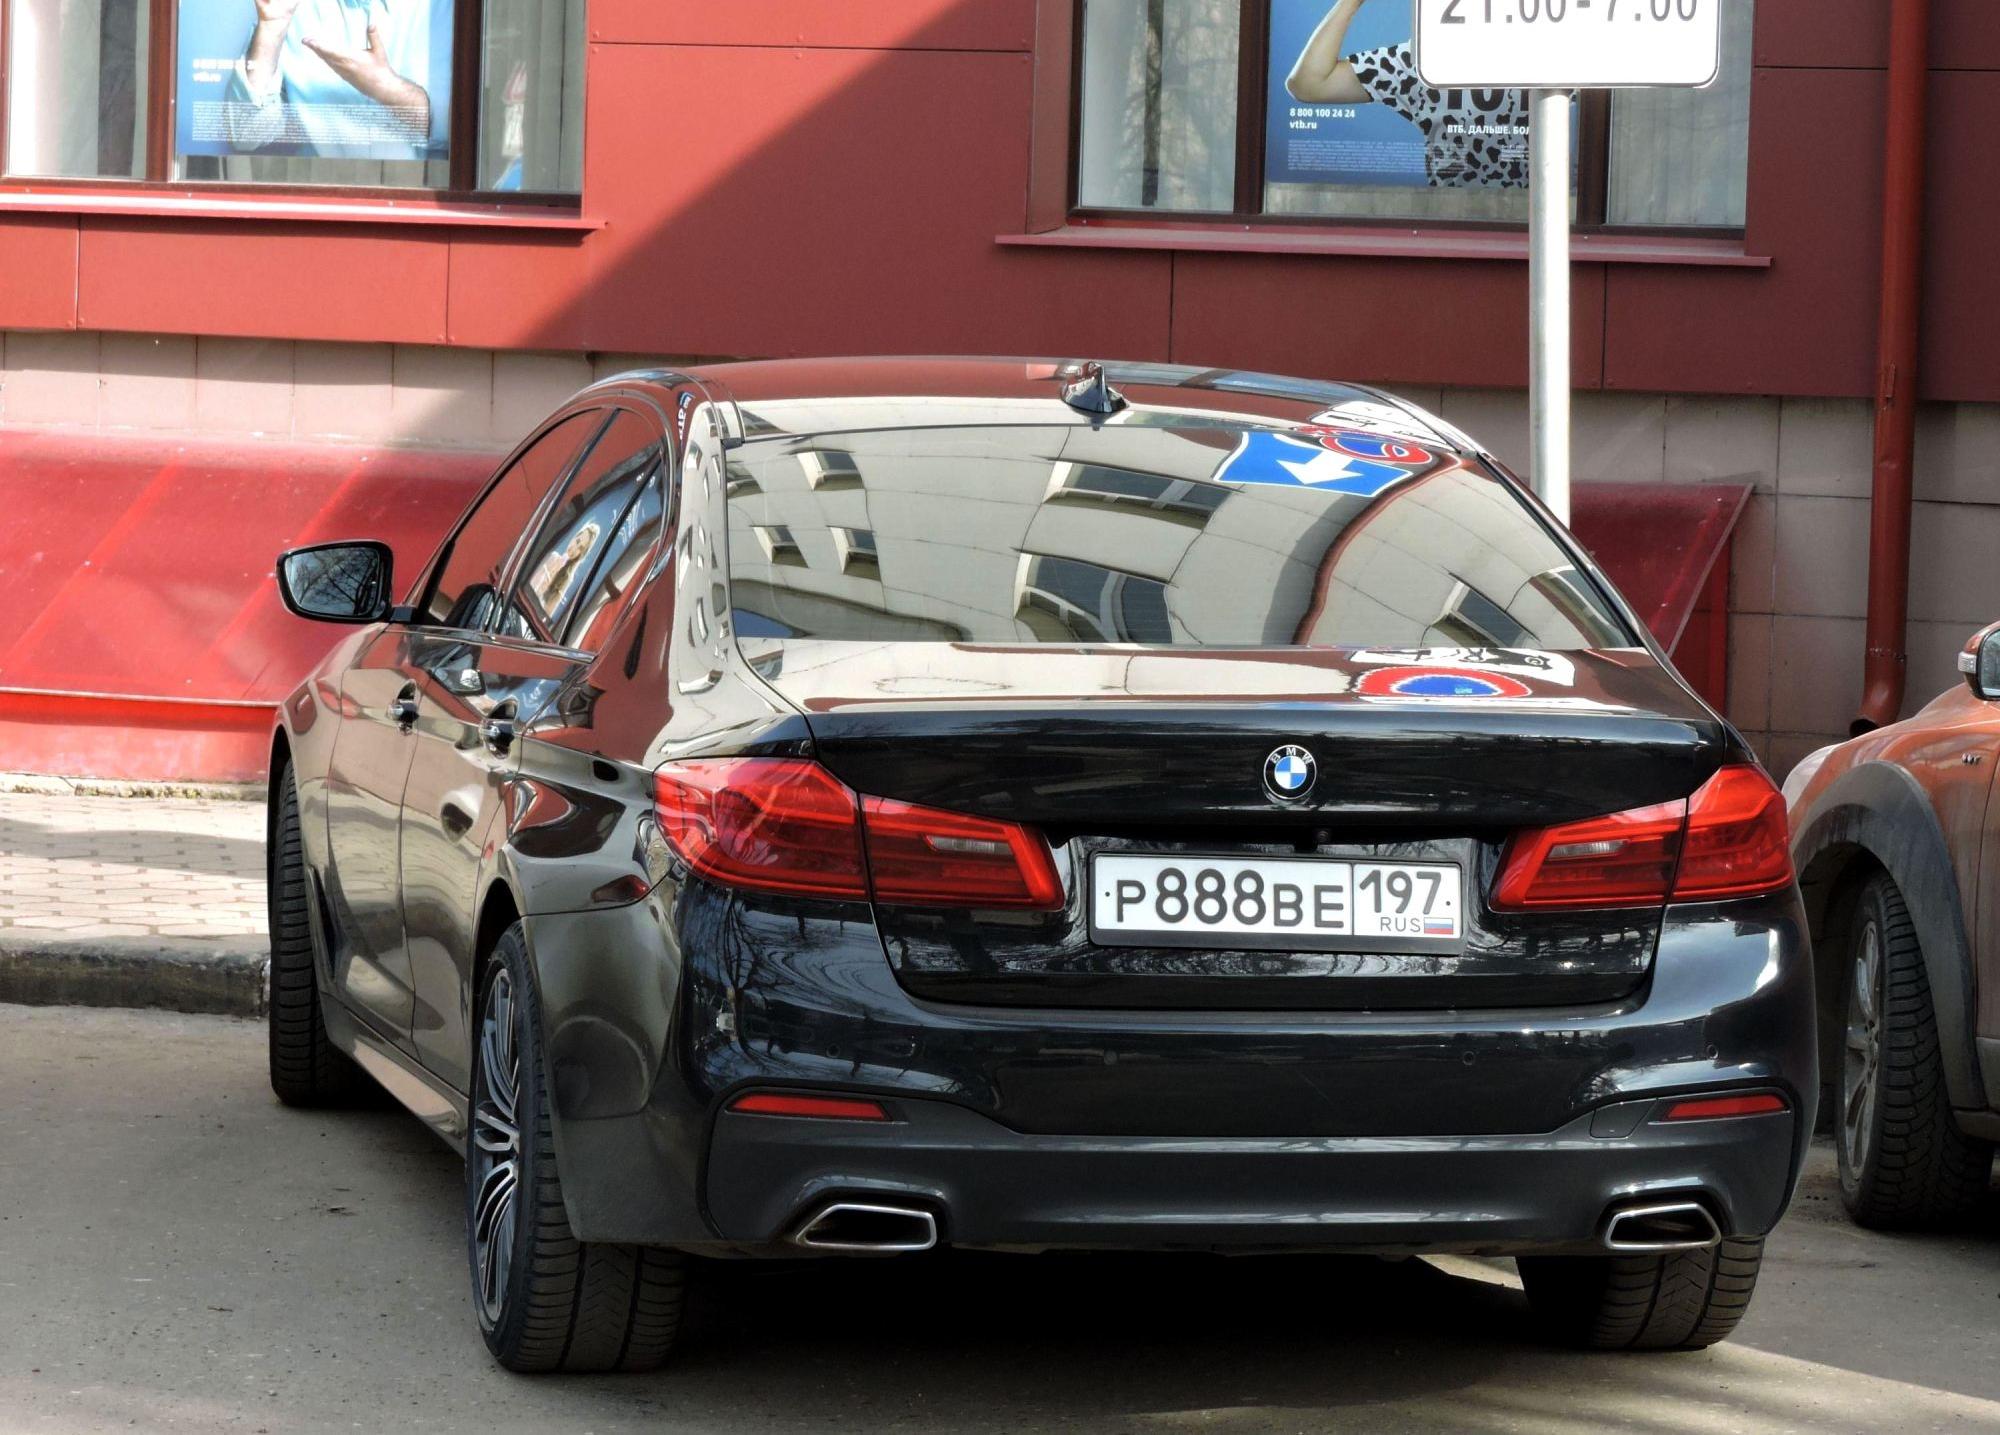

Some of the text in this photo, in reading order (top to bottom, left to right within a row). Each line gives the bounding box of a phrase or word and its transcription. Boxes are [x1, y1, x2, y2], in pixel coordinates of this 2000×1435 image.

[1289, 108, 1355, 118] 8 800 100 24 24
[1289, 120, 1317, 129] vtb.ru
[1513, 126, 1529, 135] БОЛ
[1270, 746, 1313, 765] BMW
[1358, 869, 1442, 915] 197
[1379, 916, 1421, 933] RUS
